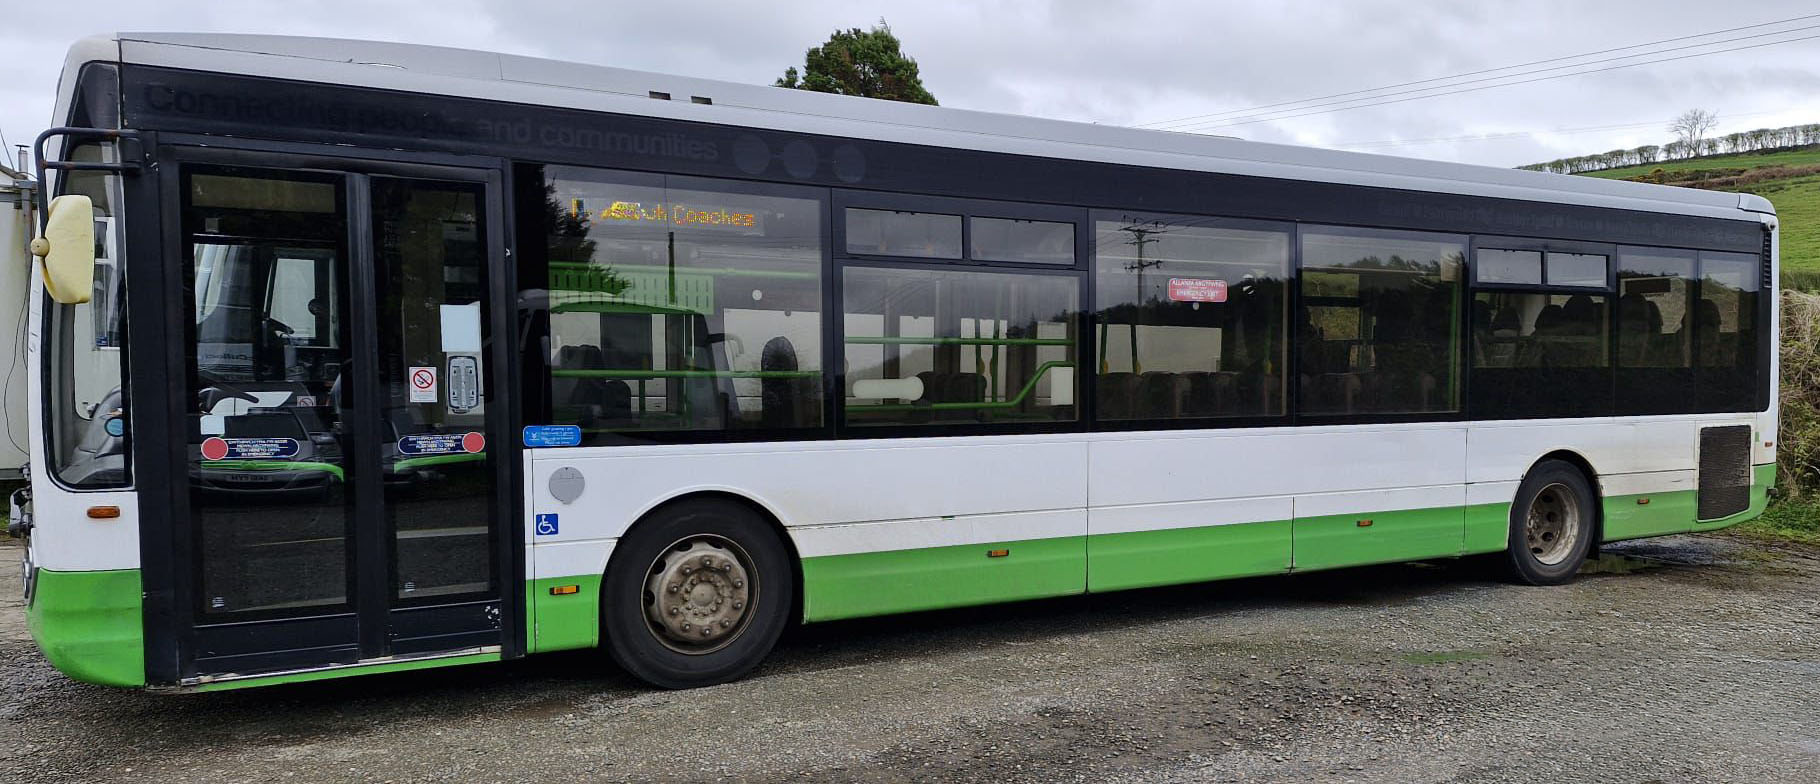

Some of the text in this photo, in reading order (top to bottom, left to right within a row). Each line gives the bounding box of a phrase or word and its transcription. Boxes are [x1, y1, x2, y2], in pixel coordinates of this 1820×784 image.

[144, 83, 351, 129] Connecting
[479, 114, 530, 143] and
[540, 125, 719, 160] communities
[672, 204, 754, 227] Coaches
